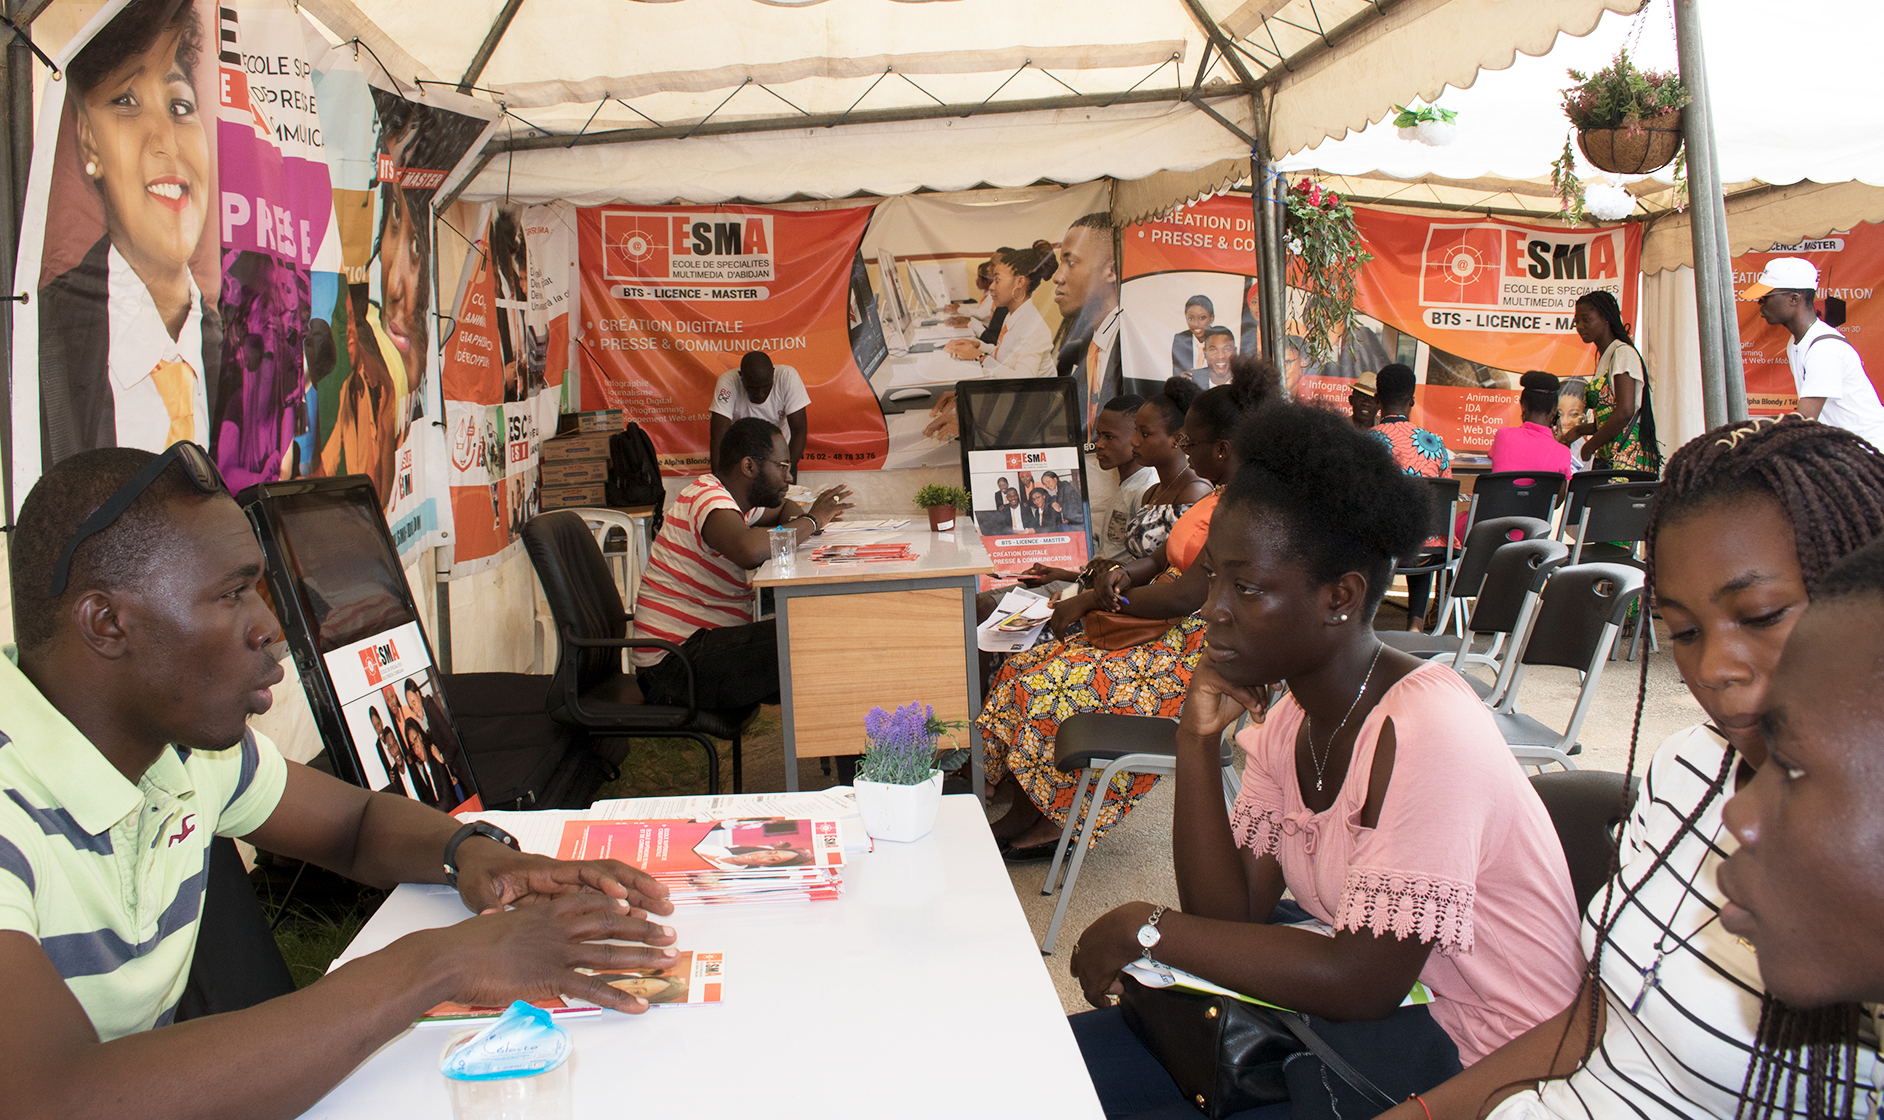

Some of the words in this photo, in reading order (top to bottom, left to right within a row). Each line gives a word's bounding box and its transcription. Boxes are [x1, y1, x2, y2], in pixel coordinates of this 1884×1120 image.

[401, 172, 444, 187] MASTER
[1235, 218, 1255, 232] DI
[672, 216, 769, 256] ESMA
[1151, 229, 1214, 248] PRESSE
[1217, 235, 1229, 250] &
[1233, 237, 1255, 252] CO
[1505, 230, 1619, 280] ESMA
[672, 260, 701, 268] ECOLE
[716, 259, 770, 268] SPECIALITES
[672, 270, 723, 279] MULTIMEDIA
[727, 270, 770, 279] D'ABIDJAN
[623, 287, 644, 297] BTS
[654, 288, 701, 298] LICENCE
[712, 289, 758, 298] MASTER
[1504, 283, 1538, 294] ECOLE
[1541, 285, 1555, 295] DE
[1503, 297, 1564, 308] MULTIMEDIA
[600, 316, 672, 333] CRÉATION
[676, 320, 743, 334] DIGITALE
[1432, 312, 1461, 326] BTS
[1476, 314, 1541, 330] LICENCE
[600, 337, 657, 351] PRESSE
[661, 338, 671, 350] &
[675, 336, 807, 352] COMMUNICATION
[605, 380, 649, 389] Infographie
[646, 397, 672, 406] Digital
[1466, 393, 1511, 403] Animation
[1761, 397, 1783, 407] Blondy
[630, 406, 684, 415] Programming
[1465, 403, 1481, 412] IDA
[669, 414, 686, 422] Web
[1464, 414, 1503, 424] RH-Com
[1463, 425, 1483, 434] Web
[664, 457, 684, 466] Alpha
[686, 457, 711, 466] Blondy
[1022, 452, 1047, 463] ESMA
[992, 550, 1021, 558] CRÉATION
[1022, 549, 1048, 557] DIGITALE
[1022, 555, 1072, 564] COMMUNICATION
[372, 638, 400, 667] ESMA
